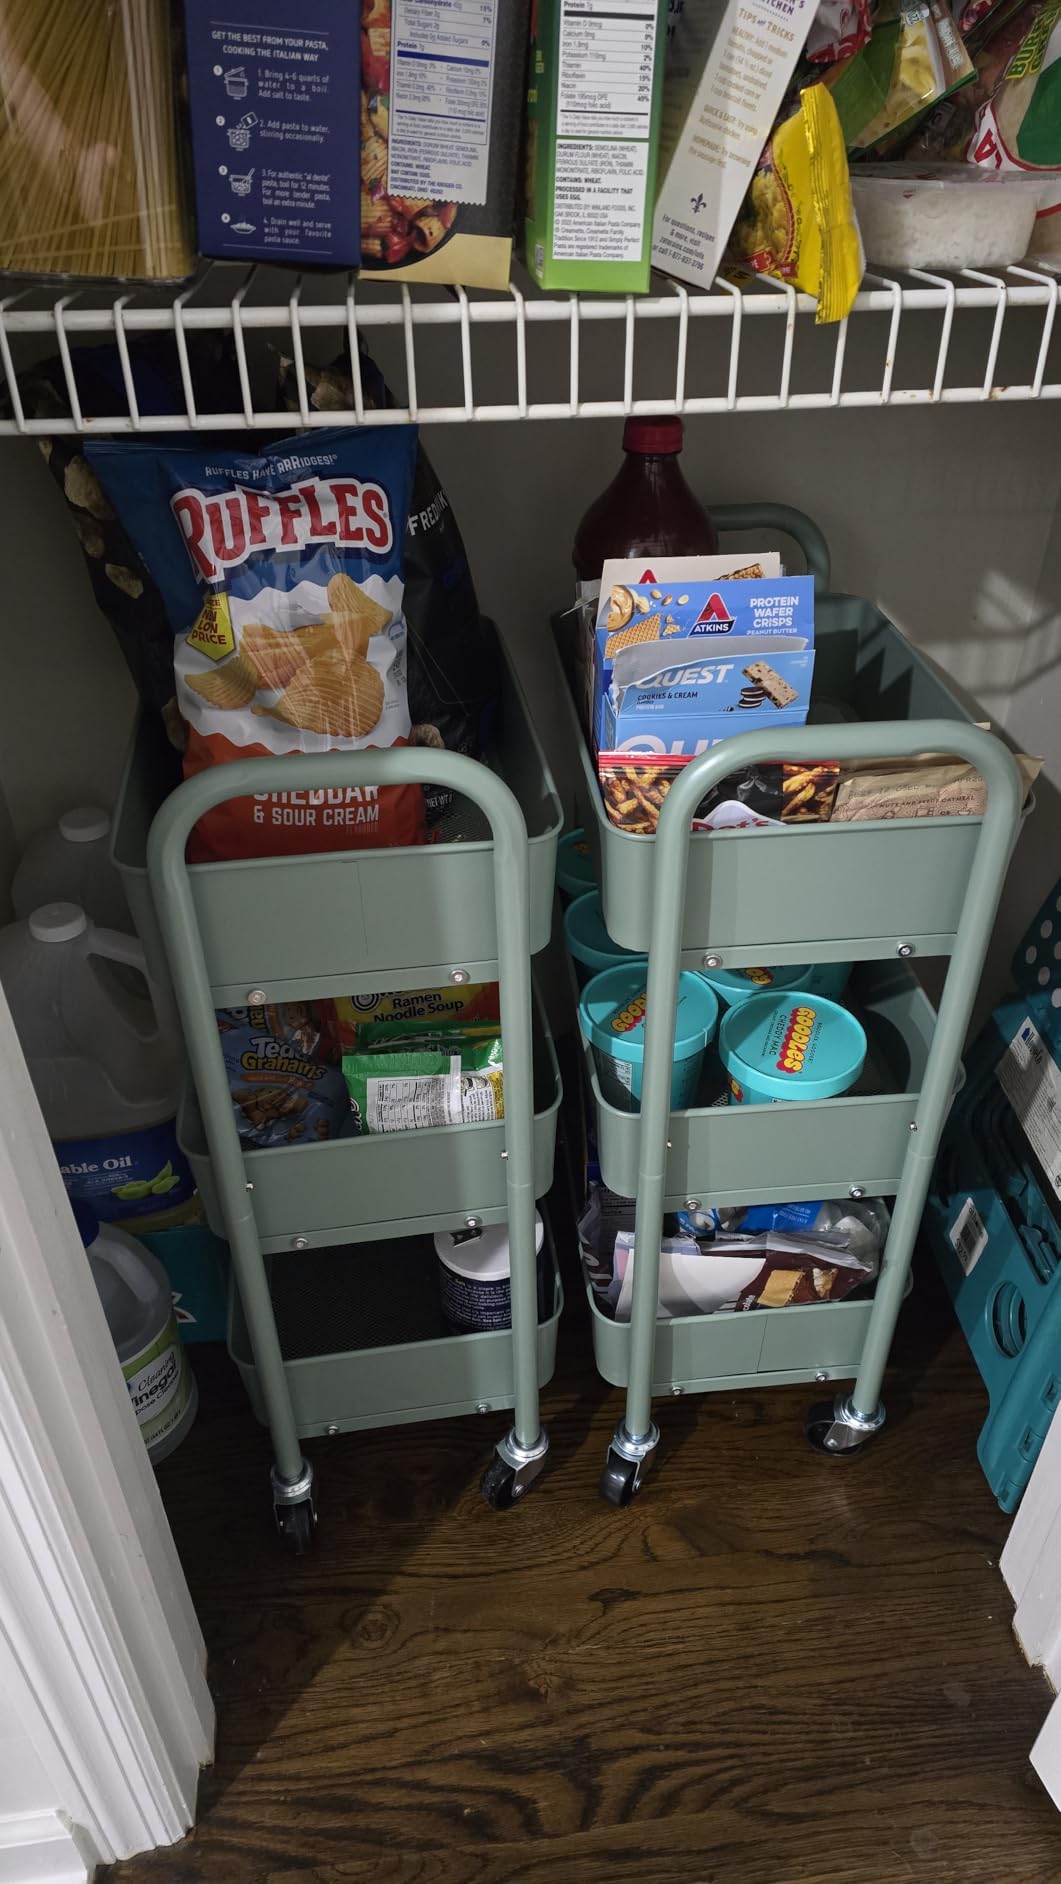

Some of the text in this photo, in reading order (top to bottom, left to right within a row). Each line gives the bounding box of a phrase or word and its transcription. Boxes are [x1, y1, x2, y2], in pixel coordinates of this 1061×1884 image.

[564, 1, 585, 9] Protein
[762, 0, 795, 15] TCHEN
[738, 8, 757, 24] TIPS
[768, 21, 795, 42] TRICKS
[212, 31, 329, 50] GET THE BEST FROM YOUR PASTA,
[397, 41, 418, 49] Protein
[223, 45, 319, 62] COOKING THE ITALIAN WAY
[265, 70, 283, 81] Bring
[299, 74, 320, 84] quarts
[287, 82, 295, 90] to
[258, 90, 271, 98] Add
[272, 91, 284, 100] salt
[285, 92, 293, 100] to
[267, 120, 280, 129] Add
[282, 123, 299, 131] pasta
[301, 123, 309, 131] to
[260, 129, 284, 140] stirring
[268, 170, 277, 178] For
[280, 180, 289, 188] boil
[262, 188, 271, 196] For
[275, 190, 290, 198] more
[288, 219, 301, 227] well
[303, 220, 314, 228] and
[264, 226, 332, 238] with your favorite
[205, 466, 249, 480] RUFFLES
[253, 464, 276, 480] HAVE
[173, 482, 390, 578] RUFFLES
[750, 596, 800, 608] PROTEIN
[754, 607, 794, 618] WAFER
[694, 623, 730, 633] ATKINS
[753, 617, 793, 628] CRISPS
[192, 630, 227, 645] PRICE
[638, 693, 666, 701] COOKIES
[254, 785, 380, 806] HEDDAR
[254, 805, 380, 826] & SOUR CREAM
[392, 993, 442, 1009] Ramen
[374, 1000, 464, 1022] Noodle Soup
[769, 1014, 787, 1056] CHEDDY MAC
[241, 1050, 328, 1080] Grahams
[103, 1156, 133, 1170] Oil
